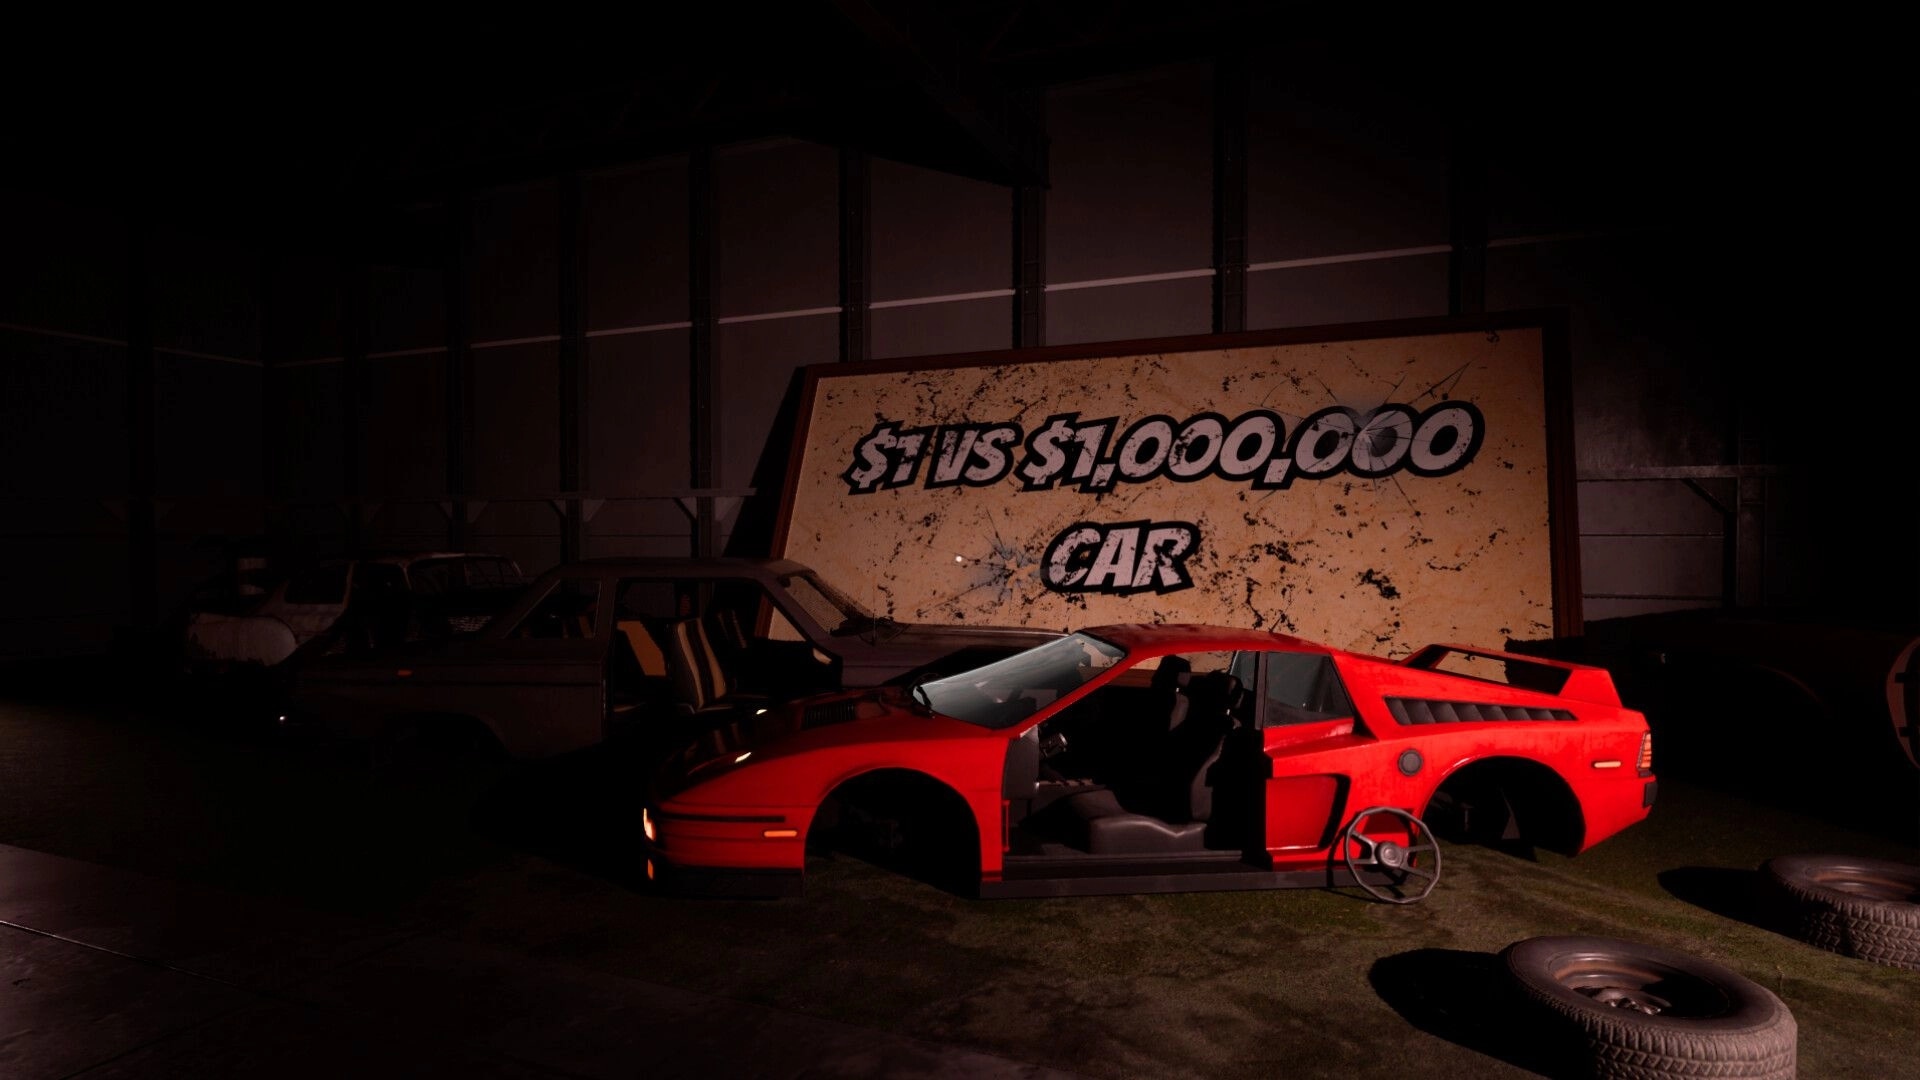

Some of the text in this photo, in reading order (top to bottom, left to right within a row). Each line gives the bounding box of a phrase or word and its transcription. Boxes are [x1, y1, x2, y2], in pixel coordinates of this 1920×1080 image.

[844, 402, 1484, 494] $1 VS $1,000,000
[1043, 521, 1198, 594] CAR
